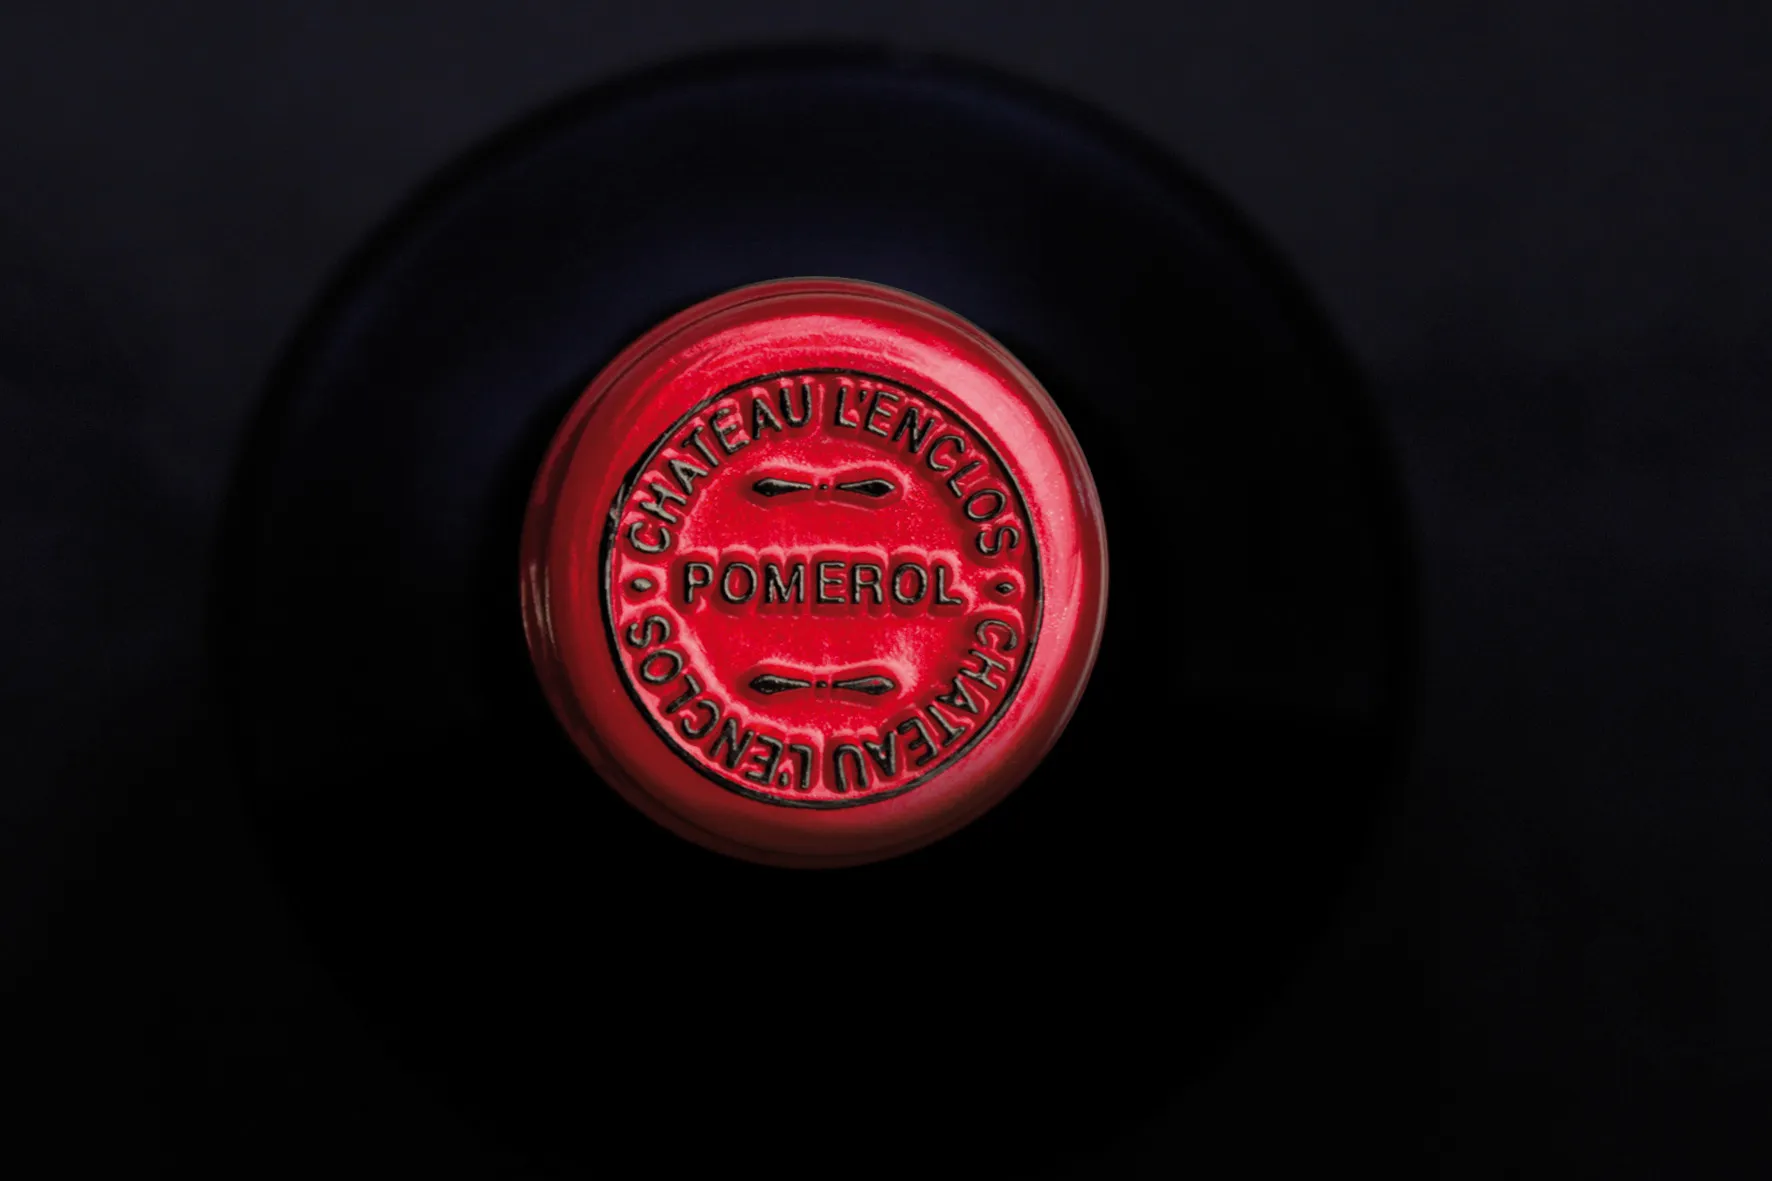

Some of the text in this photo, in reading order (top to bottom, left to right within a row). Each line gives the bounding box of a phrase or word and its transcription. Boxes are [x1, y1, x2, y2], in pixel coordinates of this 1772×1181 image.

[628, 383, 1020, 557] CHATEAU L'ENCLOS
[684, 561, 964, 605] POMEROL
[626, 614, 1018, 792] CHATEAU L'ENCLOS
